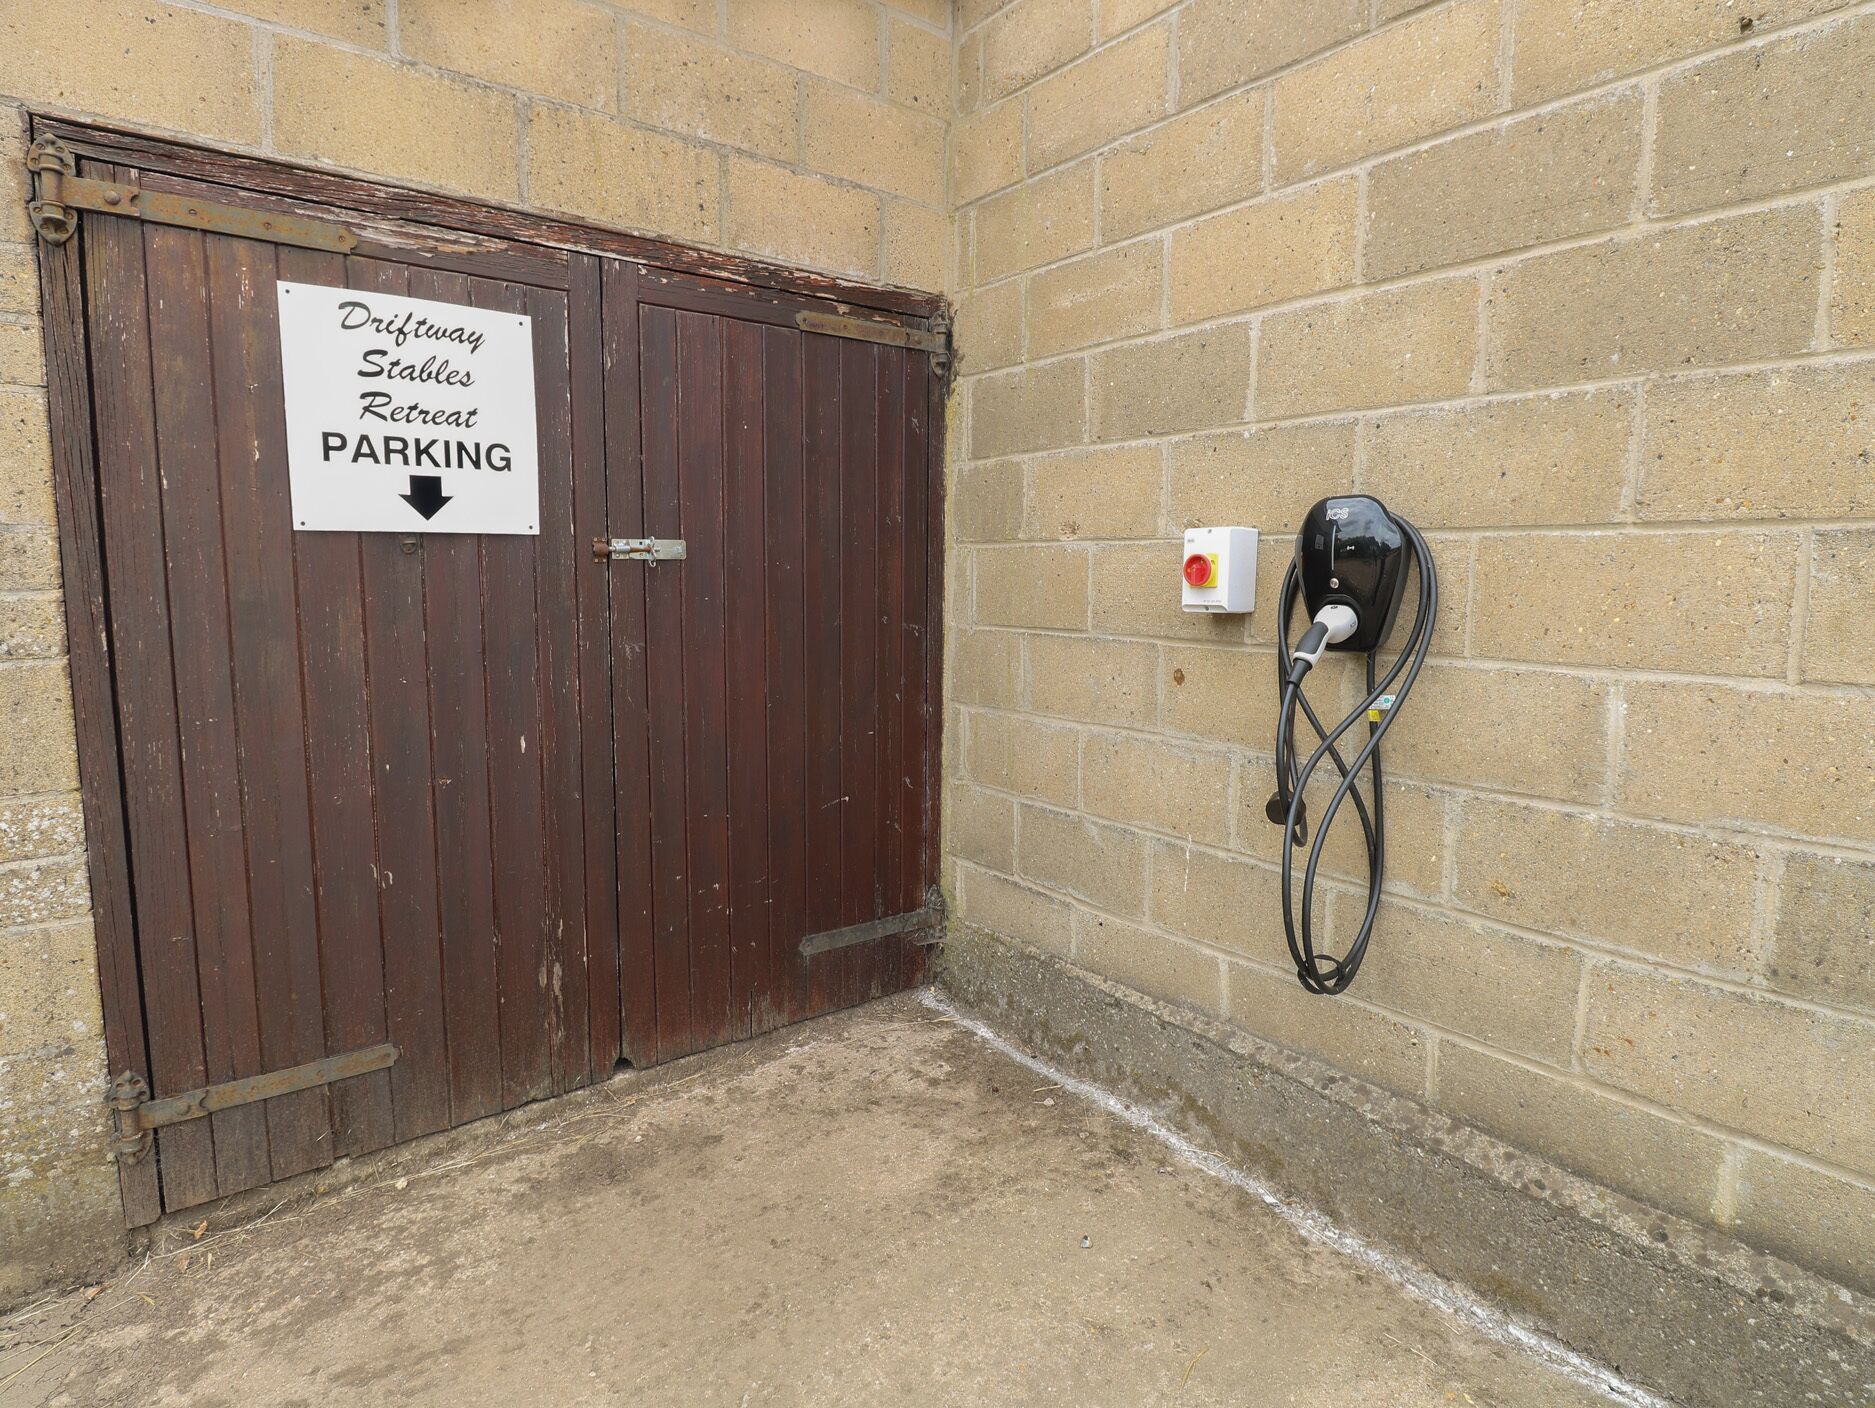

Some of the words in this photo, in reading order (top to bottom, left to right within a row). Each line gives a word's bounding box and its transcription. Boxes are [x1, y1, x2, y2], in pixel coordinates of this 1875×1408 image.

[338, 301, 486, 354] Driftway
[357, 348, 475, 387] Stables
[359, 391, 478, 429] Retreat
[321, 431, 512, 472] PARKING
